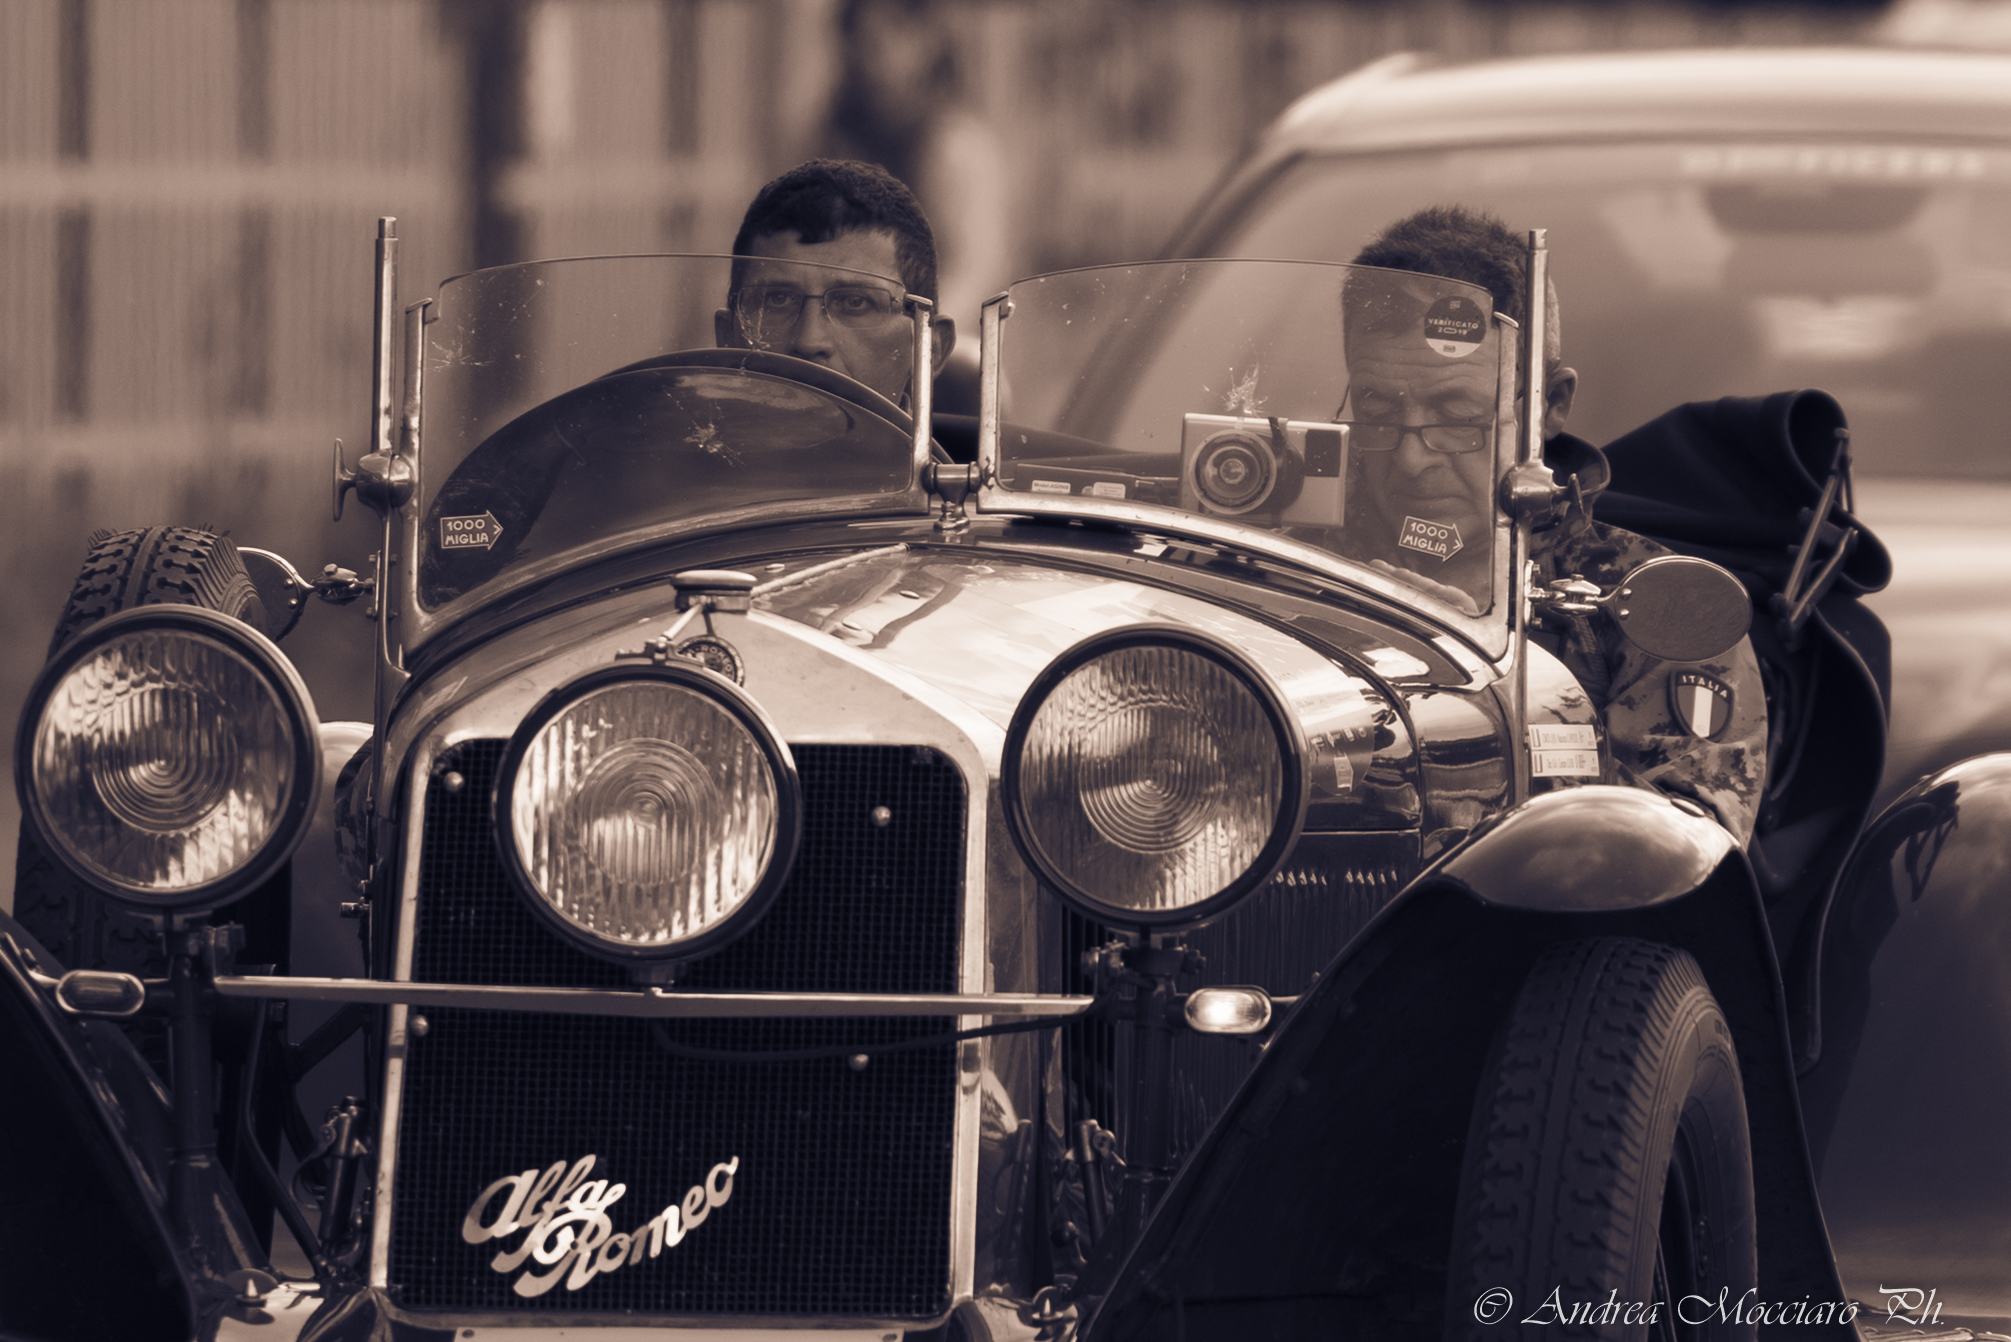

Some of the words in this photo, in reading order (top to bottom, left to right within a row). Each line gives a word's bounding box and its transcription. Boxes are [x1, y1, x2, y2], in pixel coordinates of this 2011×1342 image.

[1428, 318, 1479, 330] VERIFICATO
[447, 518, 486, 531] 1000
[1410, 521, 1448, 540] 1000
[445, 532, 489, 546] MIGLIA
[1403, 534, 1447, 554] MIGLIA
[1682, 675, 1727, 699] ITALIA
[462, 1154, 626, 1273] Alfa
[513, 1155, 739, 1298] Romeo
